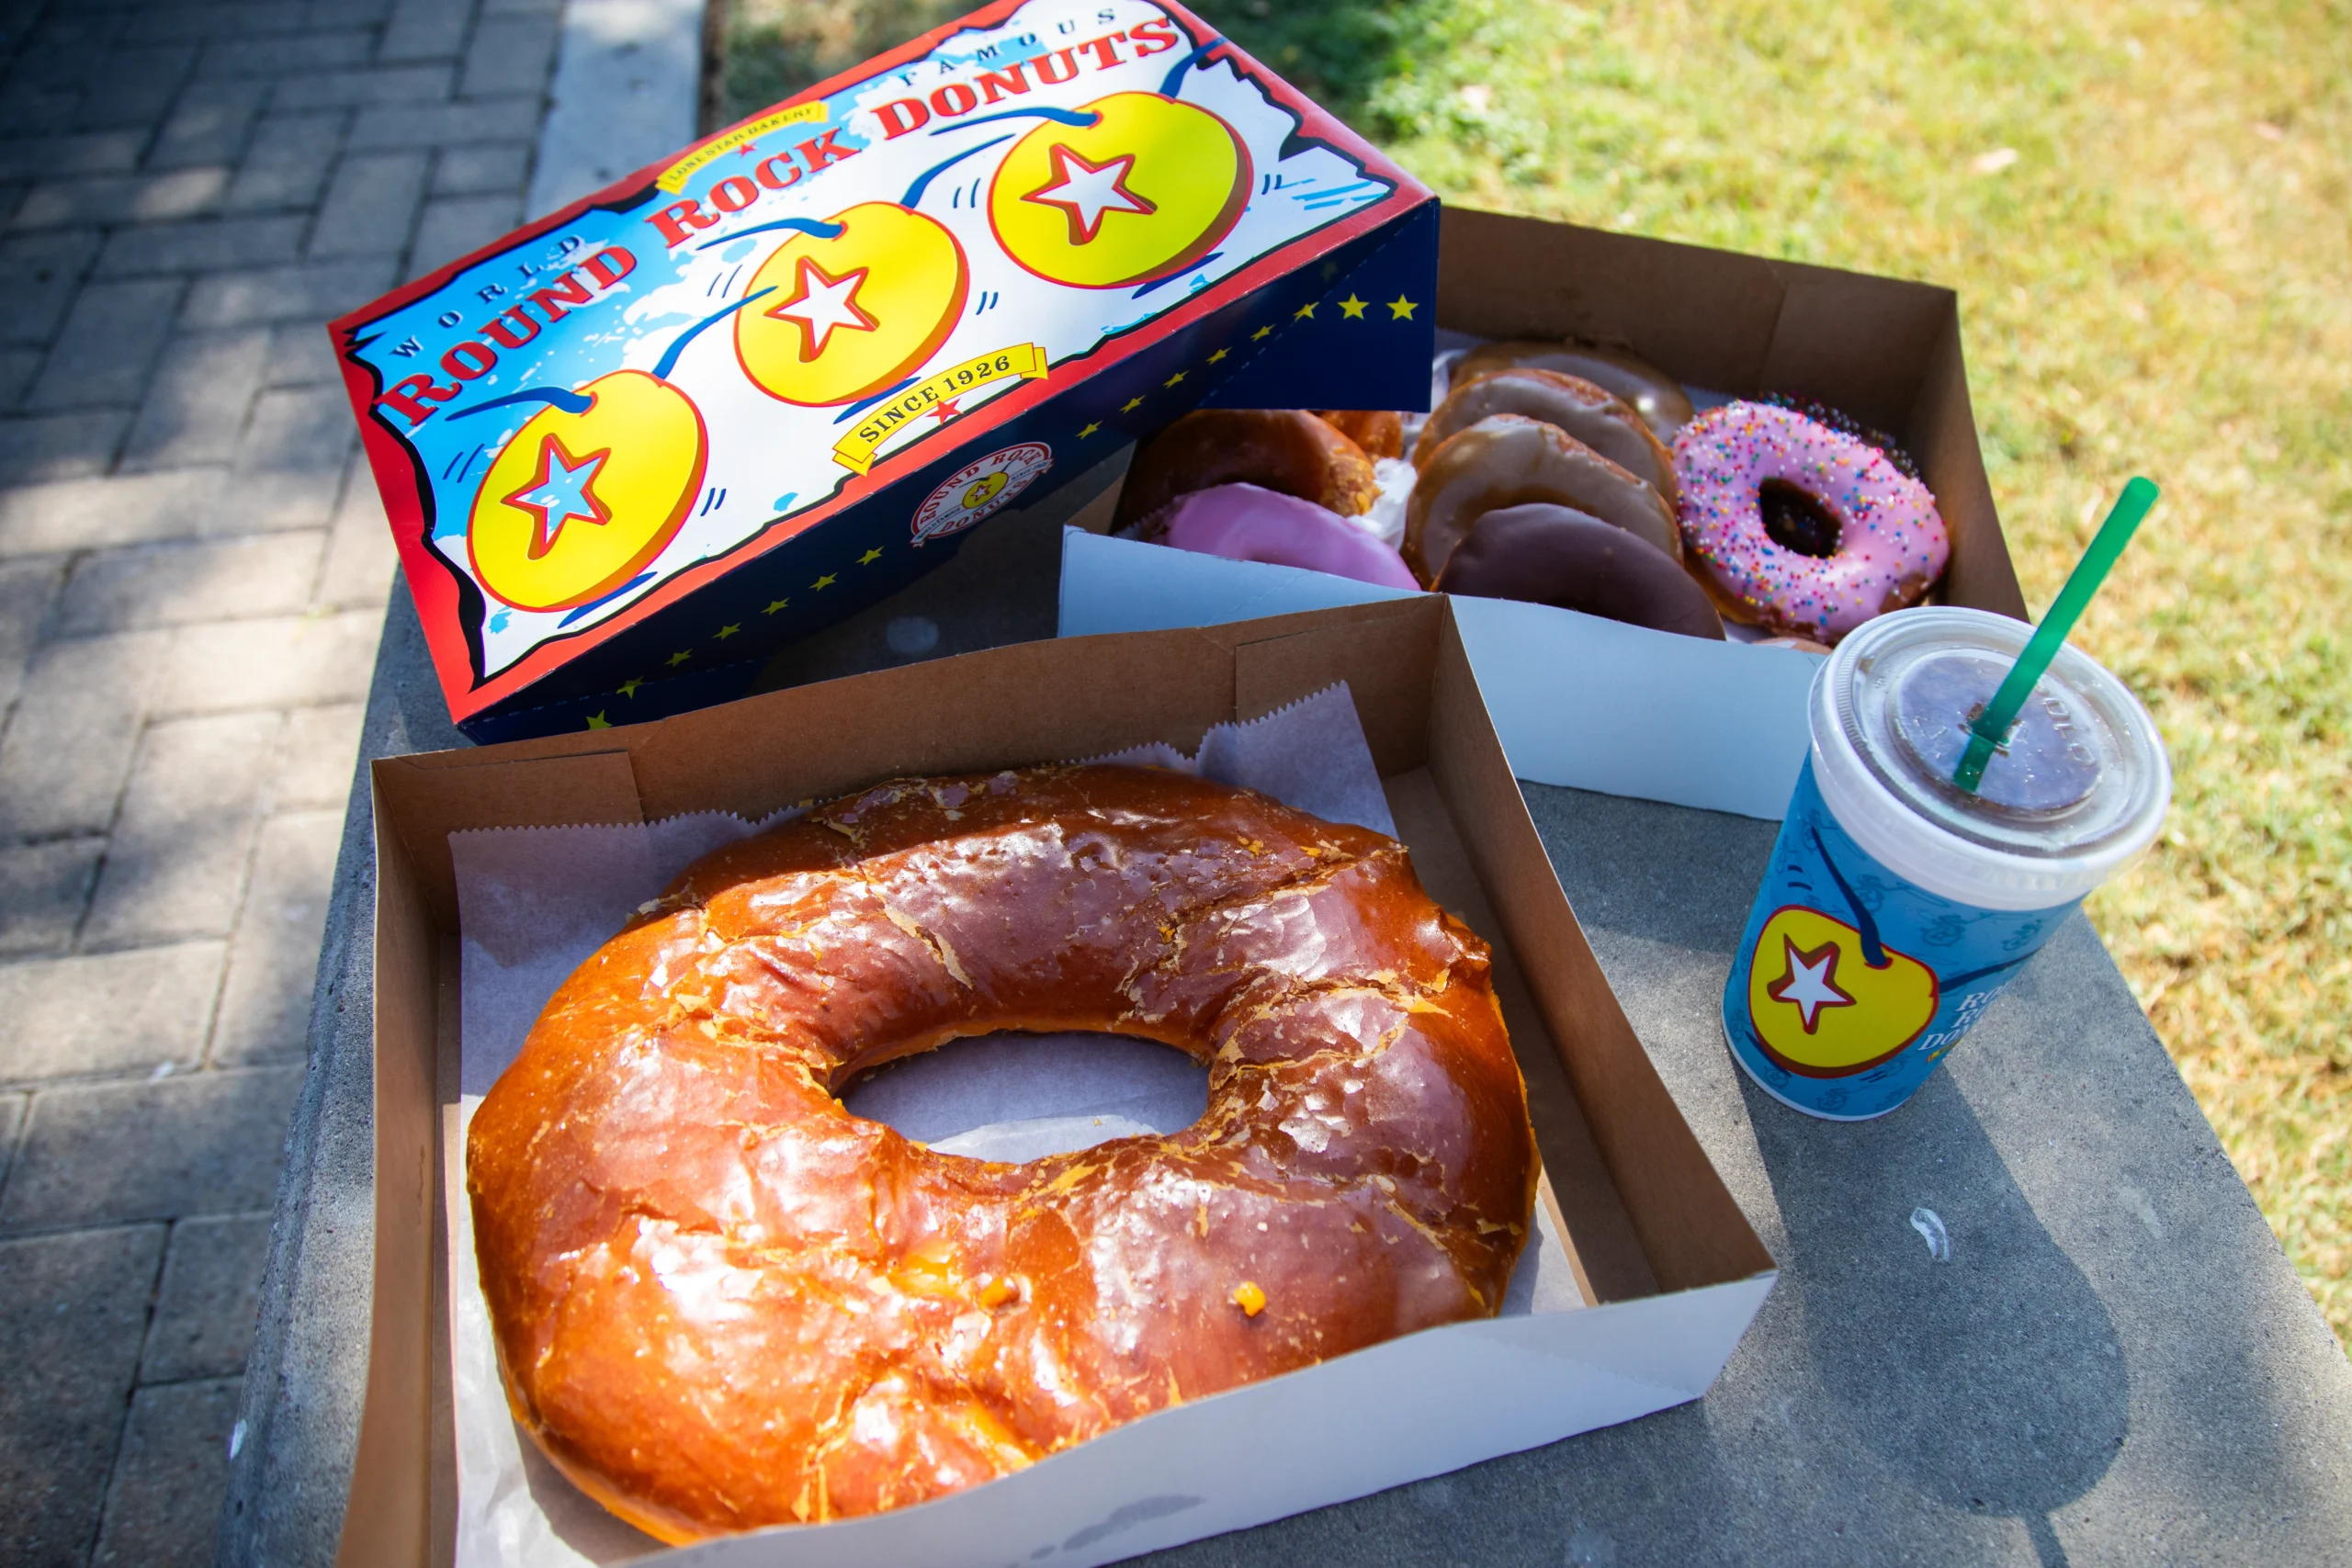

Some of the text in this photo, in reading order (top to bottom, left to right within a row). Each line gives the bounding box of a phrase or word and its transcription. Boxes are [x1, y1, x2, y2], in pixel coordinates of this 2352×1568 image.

[390, 7, 1116, 359] WORLD FAMOUS
[668, 106, 814, 181] LONE STAR BAKERY
[372, 17, 1180, 427] ROUND ROCK DONUTS
[858, 355, 1011, 444] SINCE 1926
[919, 448, 1042, 525] ROUND ROCK
[938, 479, 1029, 533] DONUTS
